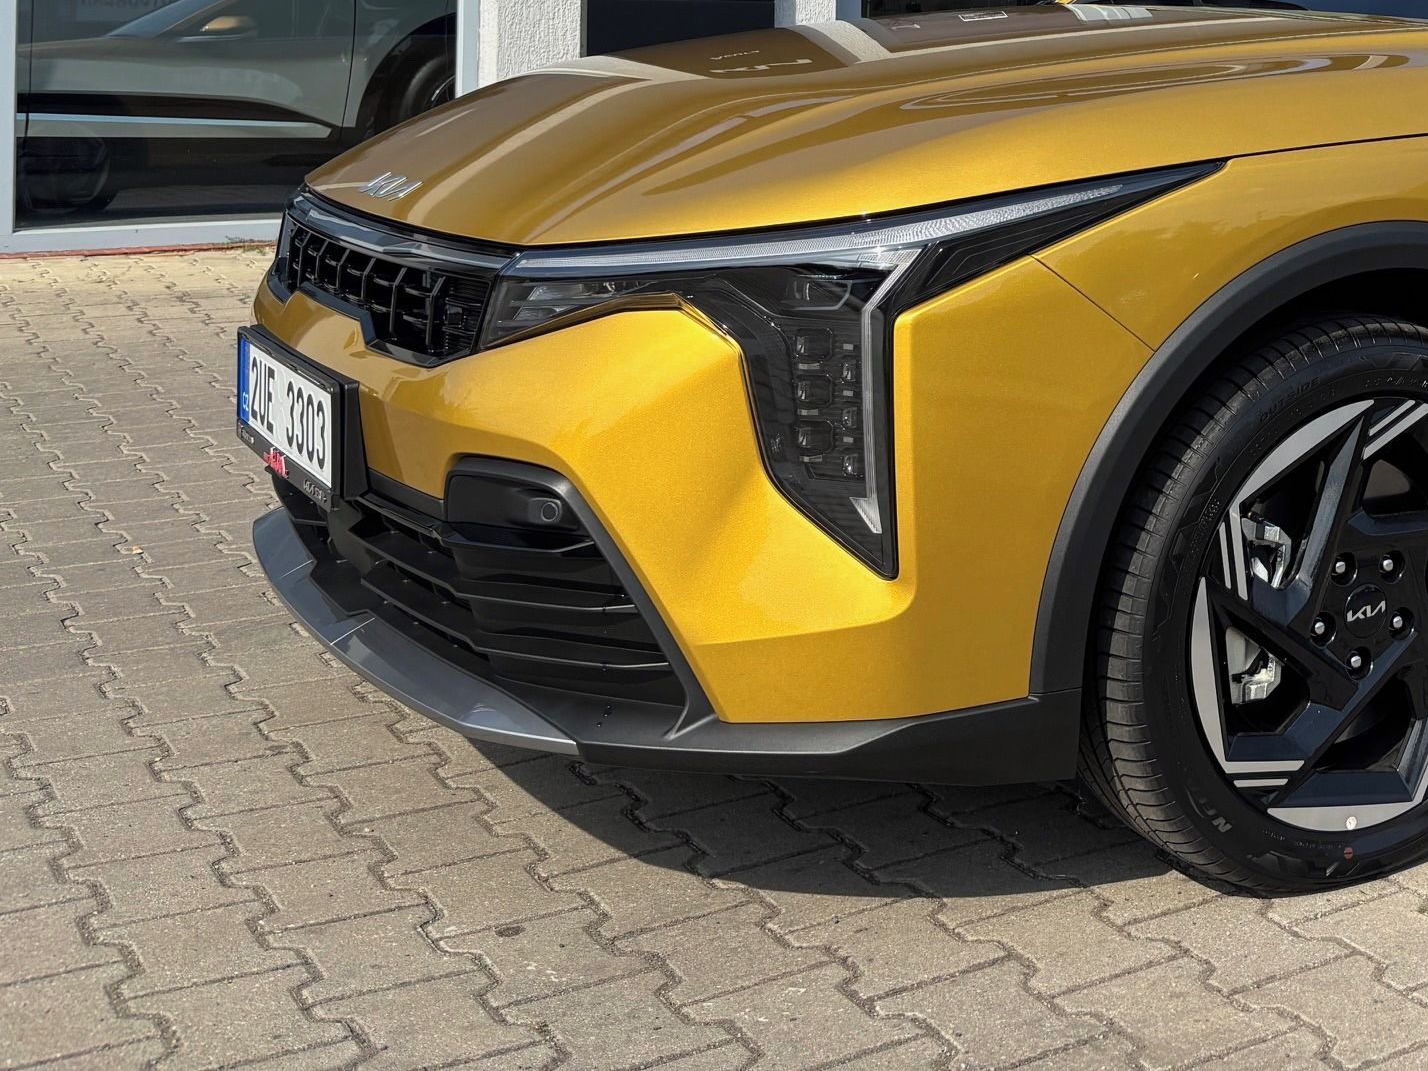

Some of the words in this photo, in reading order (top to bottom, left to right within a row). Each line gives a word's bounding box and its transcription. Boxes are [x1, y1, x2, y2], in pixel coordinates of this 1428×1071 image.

[242, 392, 249, 411] CZ
[251, 356, 276, 435] 2UE
[286, 380, 326, 470] 3303
[1346, 600, 1386, 622] KIA
